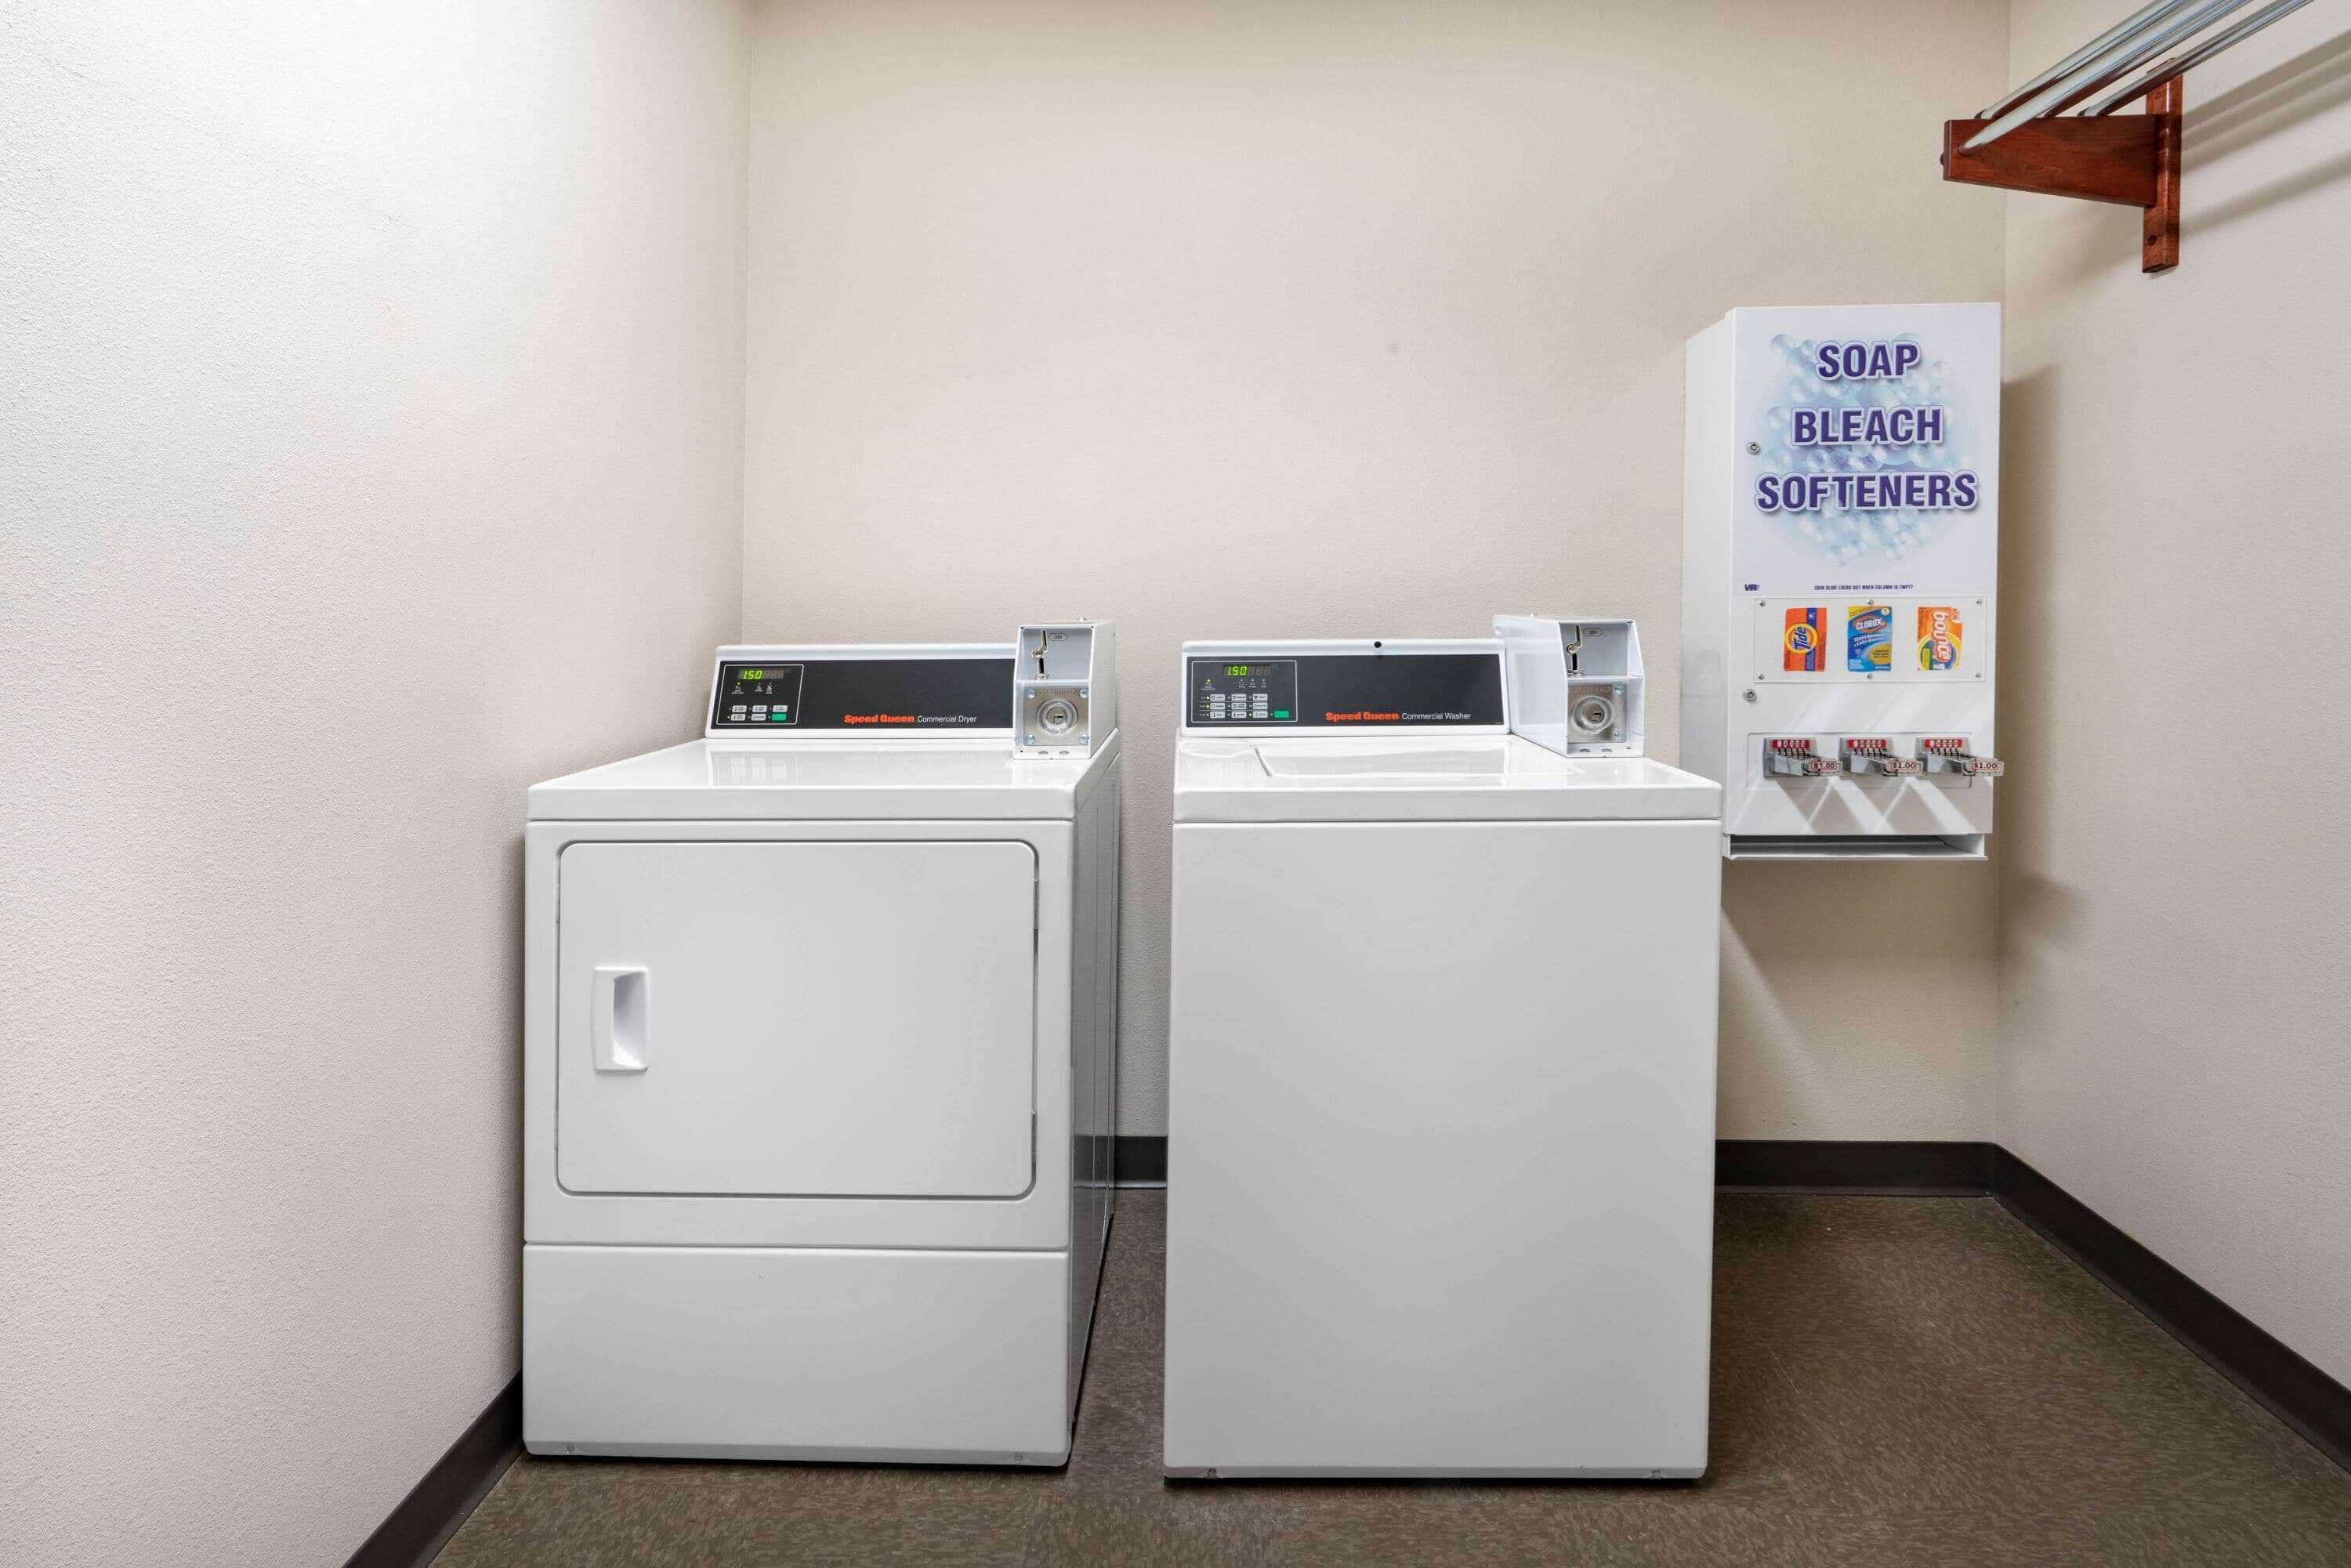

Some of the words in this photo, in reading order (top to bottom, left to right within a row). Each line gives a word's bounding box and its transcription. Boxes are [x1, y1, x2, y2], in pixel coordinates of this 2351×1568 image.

[1817, 342, 1919, 378] SOAP
[1791, 407, 1943, 444] BLEACH
[1755, 472, 1978, 510] SOFTENERS
[1793, 627, 1811, 650] Tide
[1933, 610, 1951, 661] bounce
[843, 714, 878, 724] Speed
[880, 714, 915, 722] Queen
[958, 715, 977, 724] Dryer
[1324, 712, 1361, 722] Speed
[1363, 712, 1400, 720] Queen
